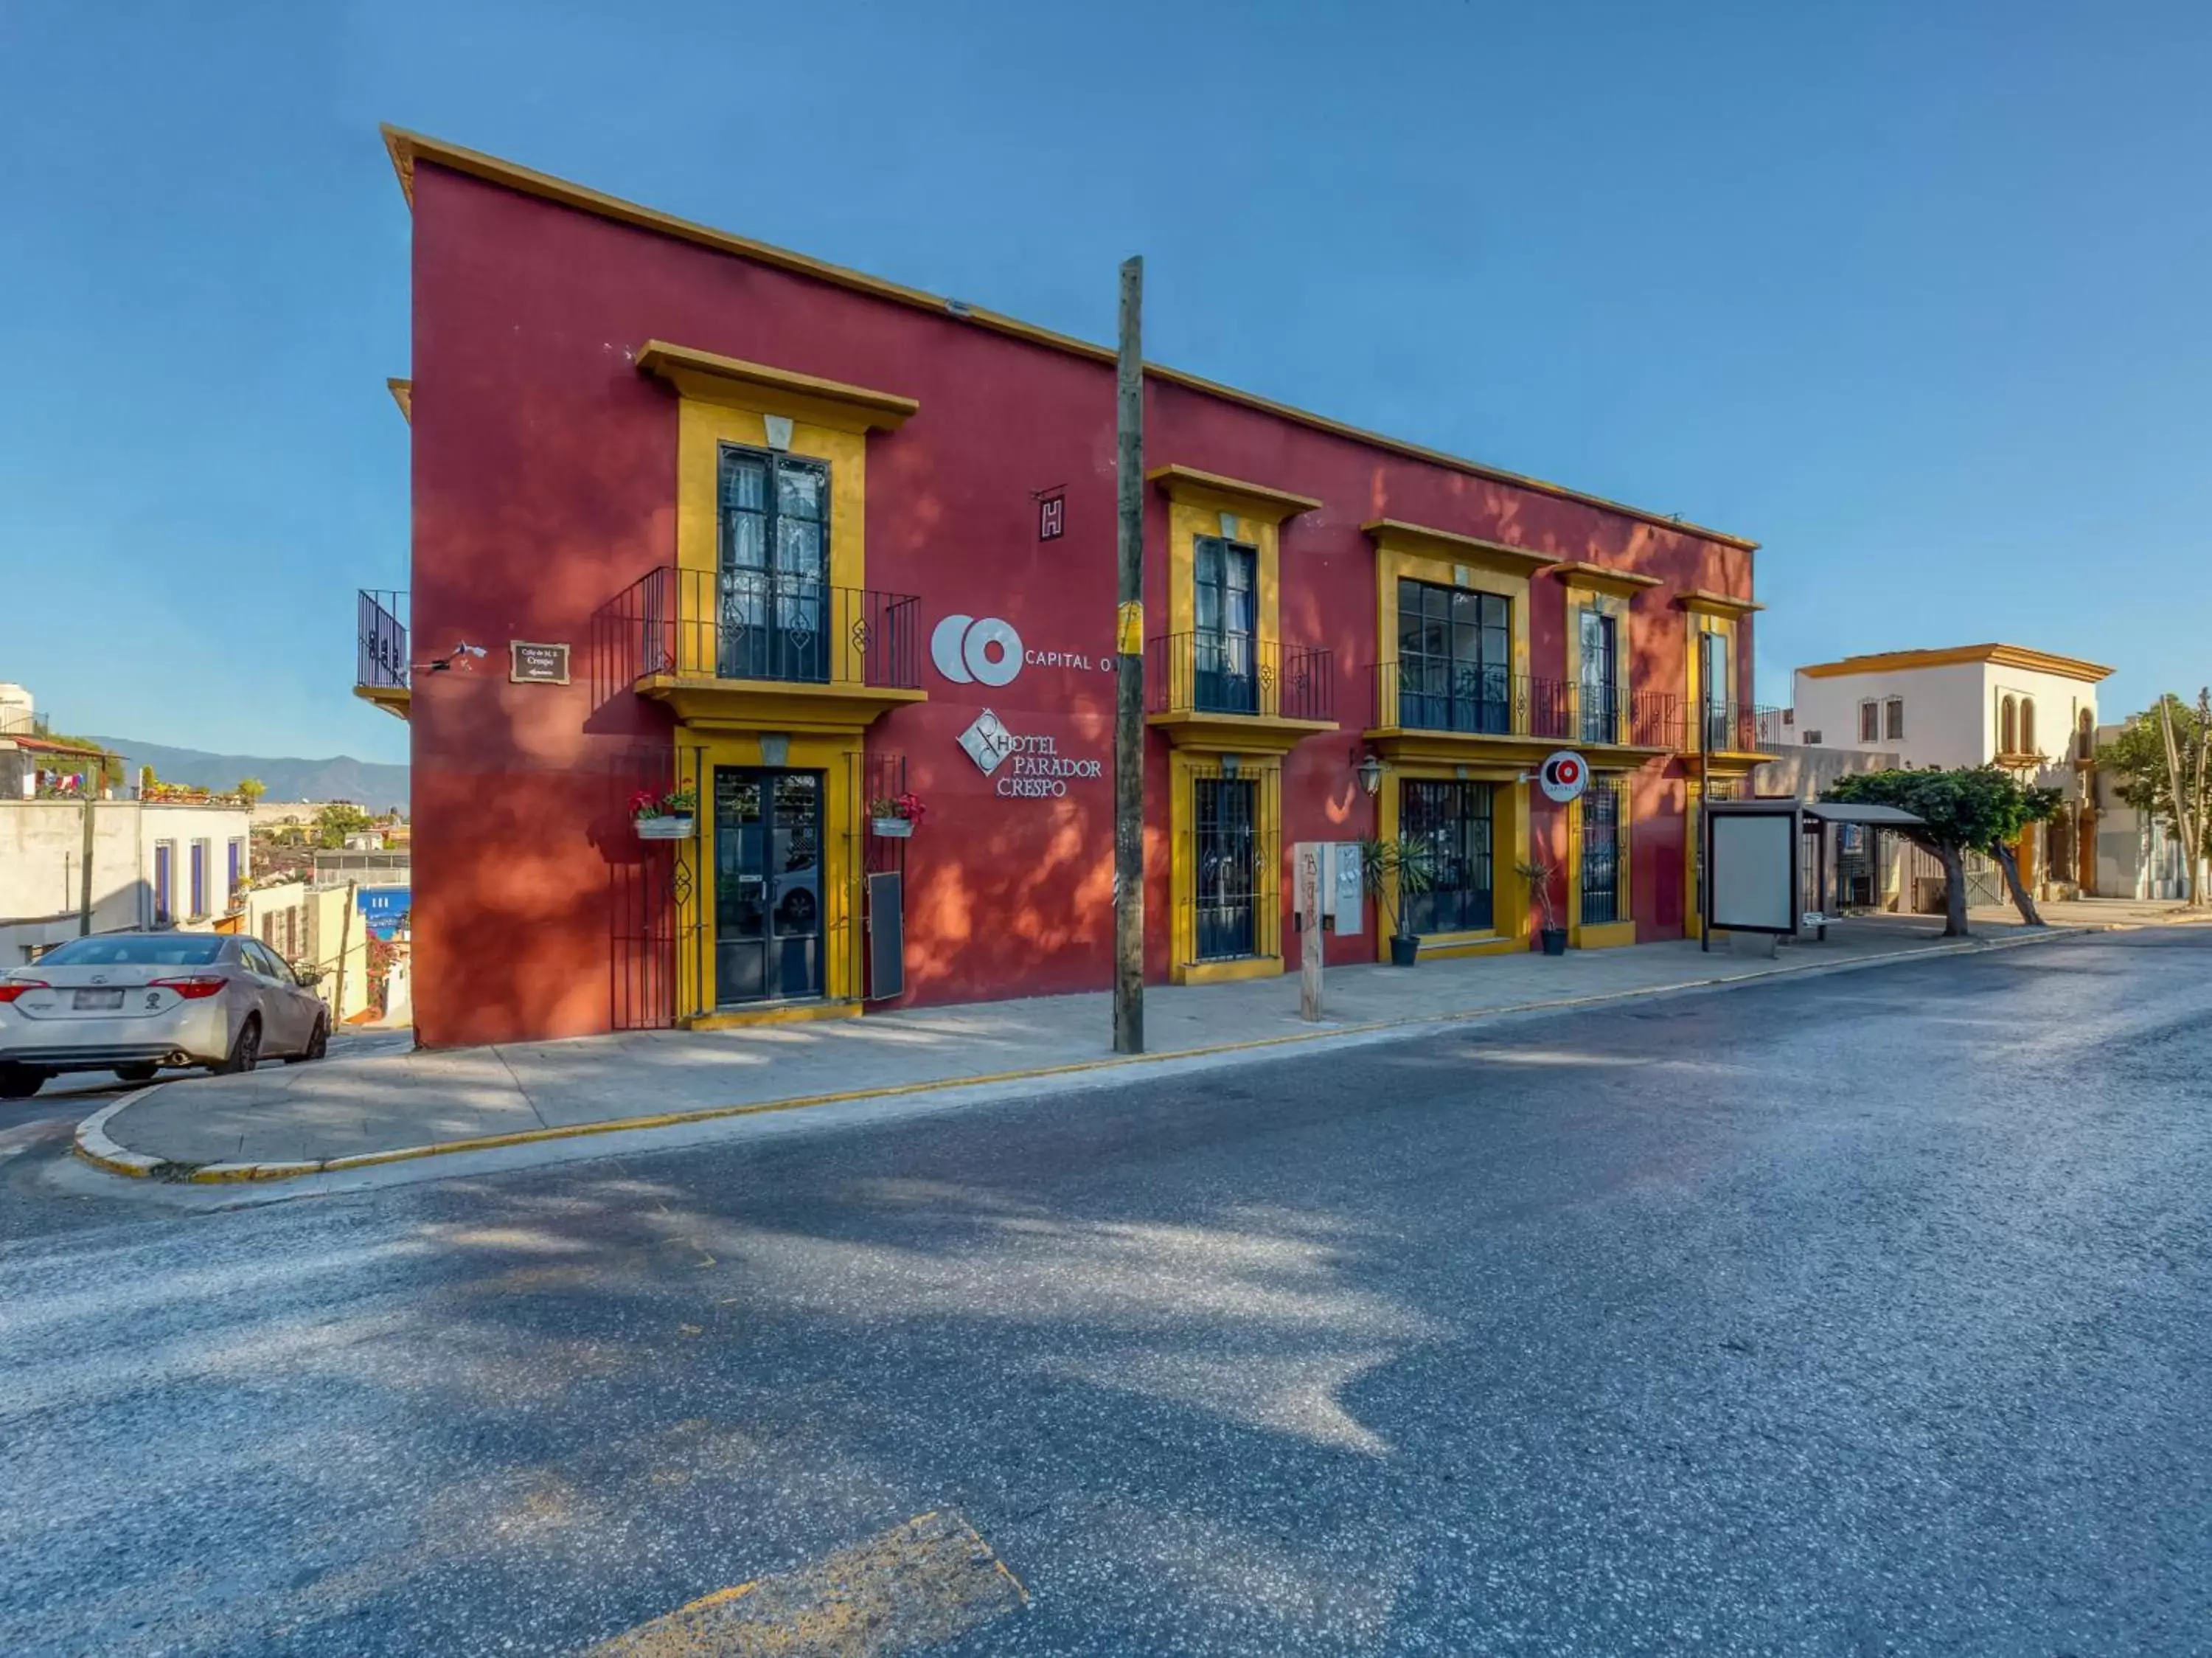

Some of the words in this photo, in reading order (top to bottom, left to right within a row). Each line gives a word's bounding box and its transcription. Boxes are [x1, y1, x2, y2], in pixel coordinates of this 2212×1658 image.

[1043, 500, 1062, 538] H
[1026, 650, 1092, 670] CAPITAL
[1101, 658, 1111, 672] O
[998, 735, 1057, 755] HOTEL
[1013, 755, 1102, 778] PARADOR
[997, 777, 1067, 797] CRESPO
